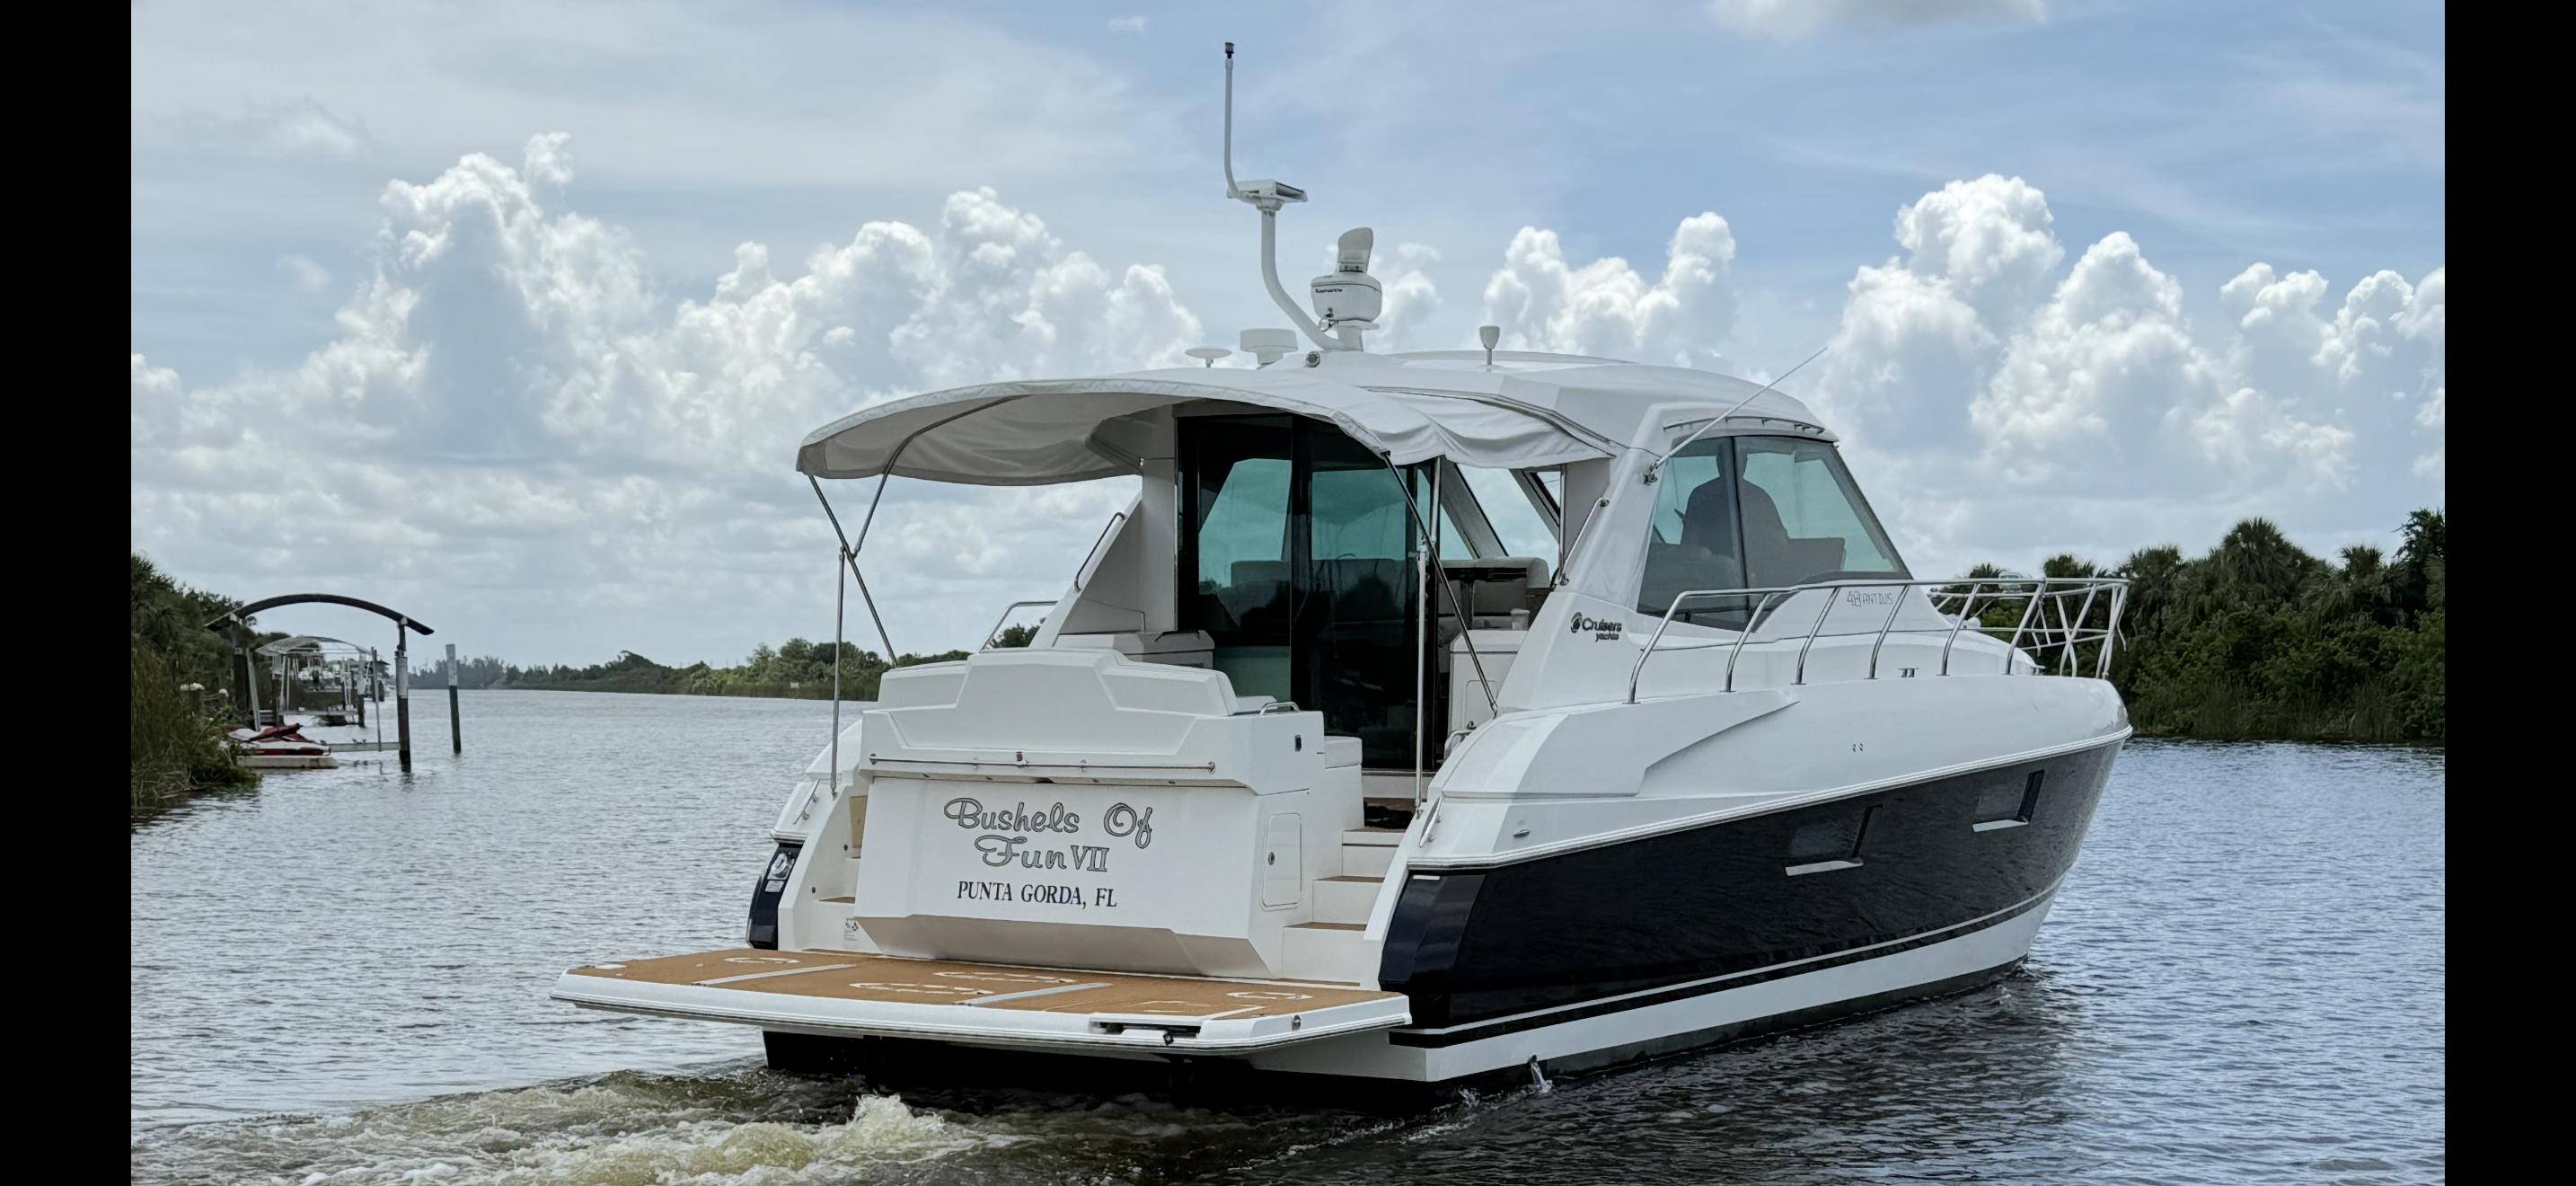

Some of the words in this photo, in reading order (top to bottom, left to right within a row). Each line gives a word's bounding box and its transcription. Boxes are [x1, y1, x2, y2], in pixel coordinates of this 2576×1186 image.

[1582, 617, 1622, 633] Cruisers
[944, 797, 1080, 833] Bushels
[1103, 802, 1153, 848] Of
[975, 835, 1067, 869] Fun
[1071, 845, 1109, 872] VII
[957, 881, 1013, 901] PUNTA
[1020, 884, 1086, 909] GORDA,
[1095, 888, 1117, 907] FL
